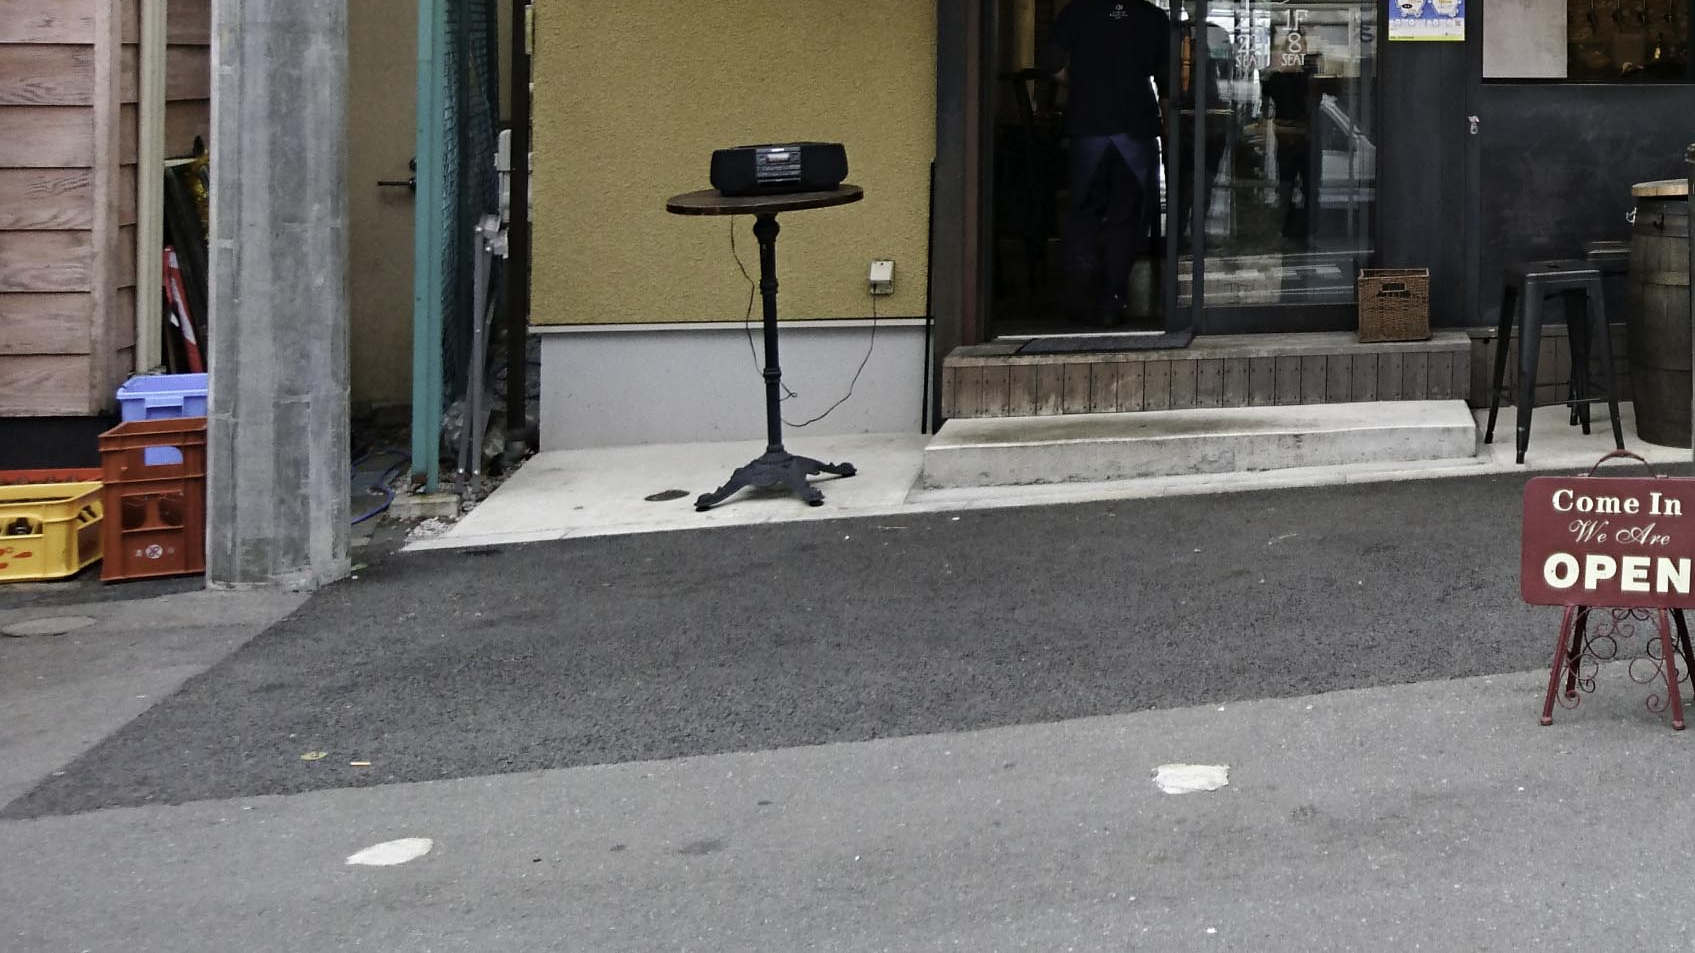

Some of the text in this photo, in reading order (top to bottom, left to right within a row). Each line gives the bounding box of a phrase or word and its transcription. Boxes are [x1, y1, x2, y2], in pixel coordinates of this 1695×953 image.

[1287, 32, 1302, 53] 8
[1281, 53, 1306, 66] SEAT
[1552, 489, 1683, 516] Come In
[1568, 519, 1671, 546] We Are
[1543, 552, 1692, 594] OPEN
